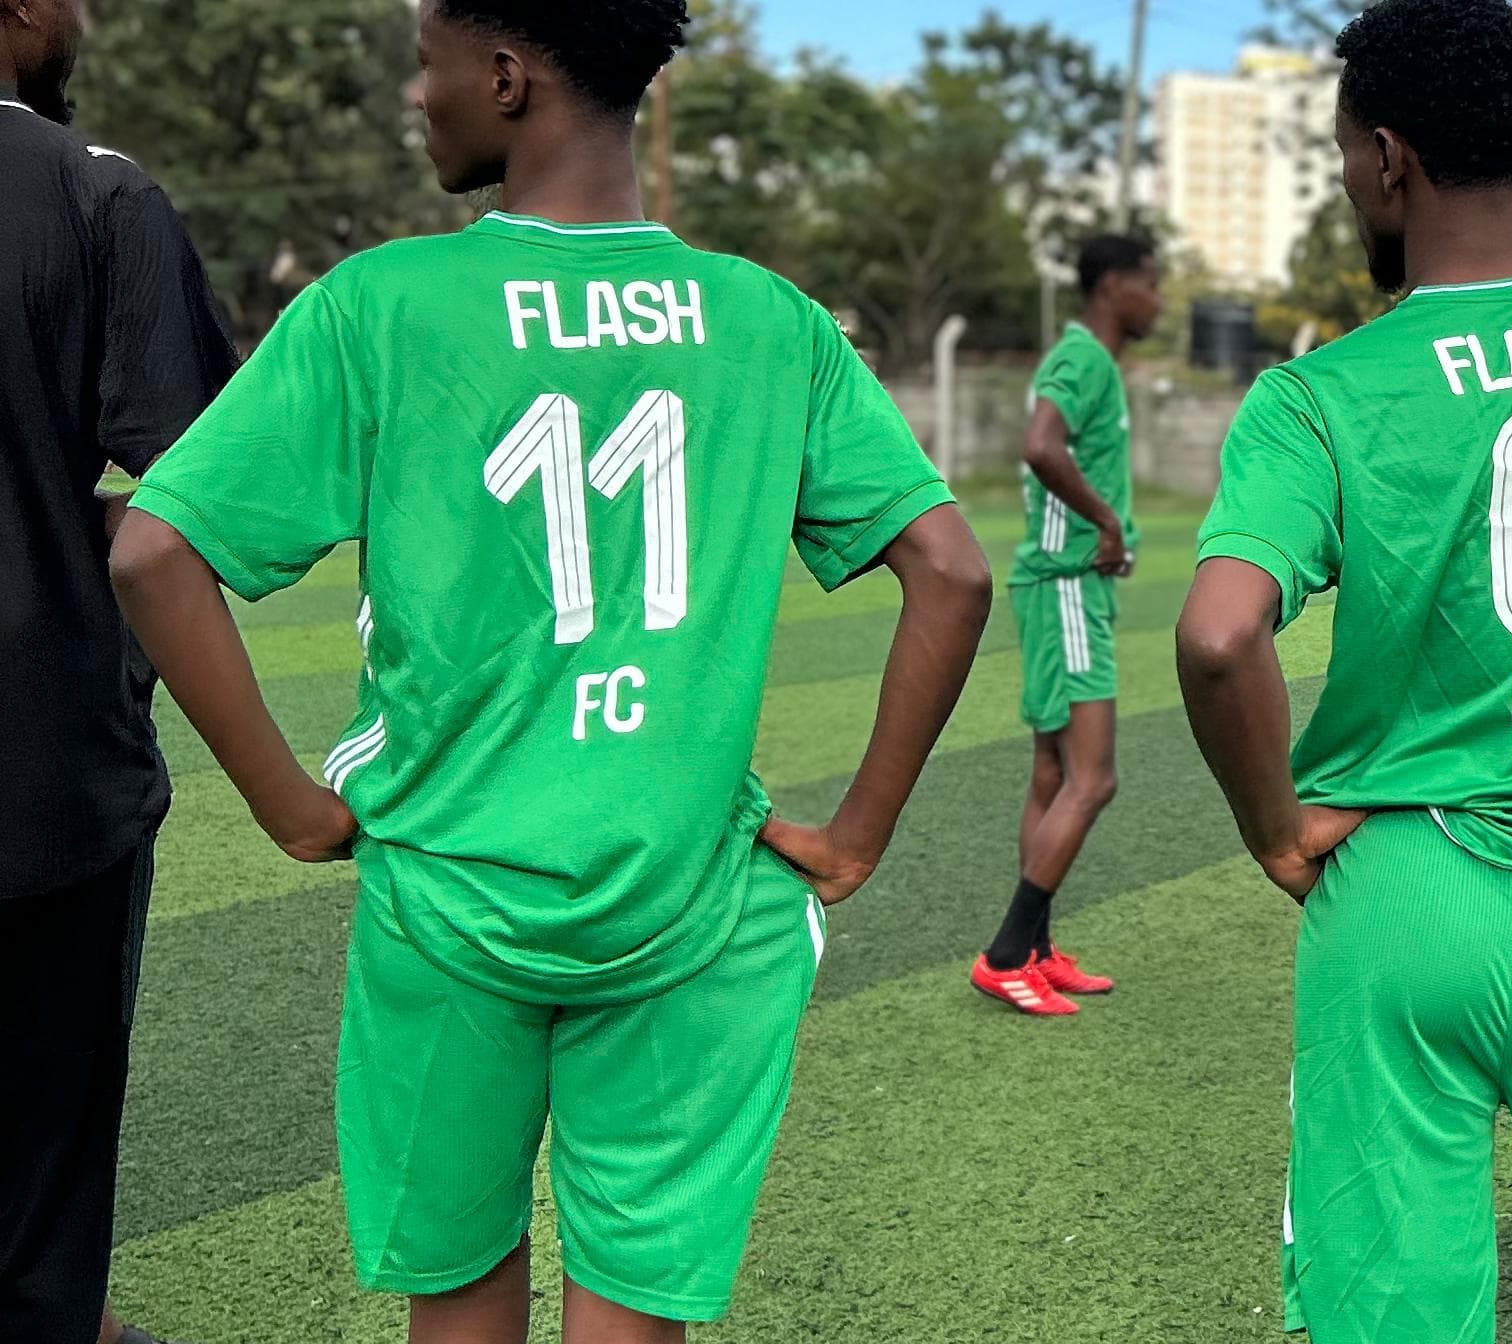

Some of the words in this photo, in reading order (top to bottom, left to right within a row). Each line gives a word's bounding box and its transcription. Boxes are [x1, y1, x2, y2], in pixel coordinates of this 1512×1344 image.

[503, 278, 706, 351] FLASH
[482, 389, 691, 645] 11
[571, 664, 649, 741] FC
